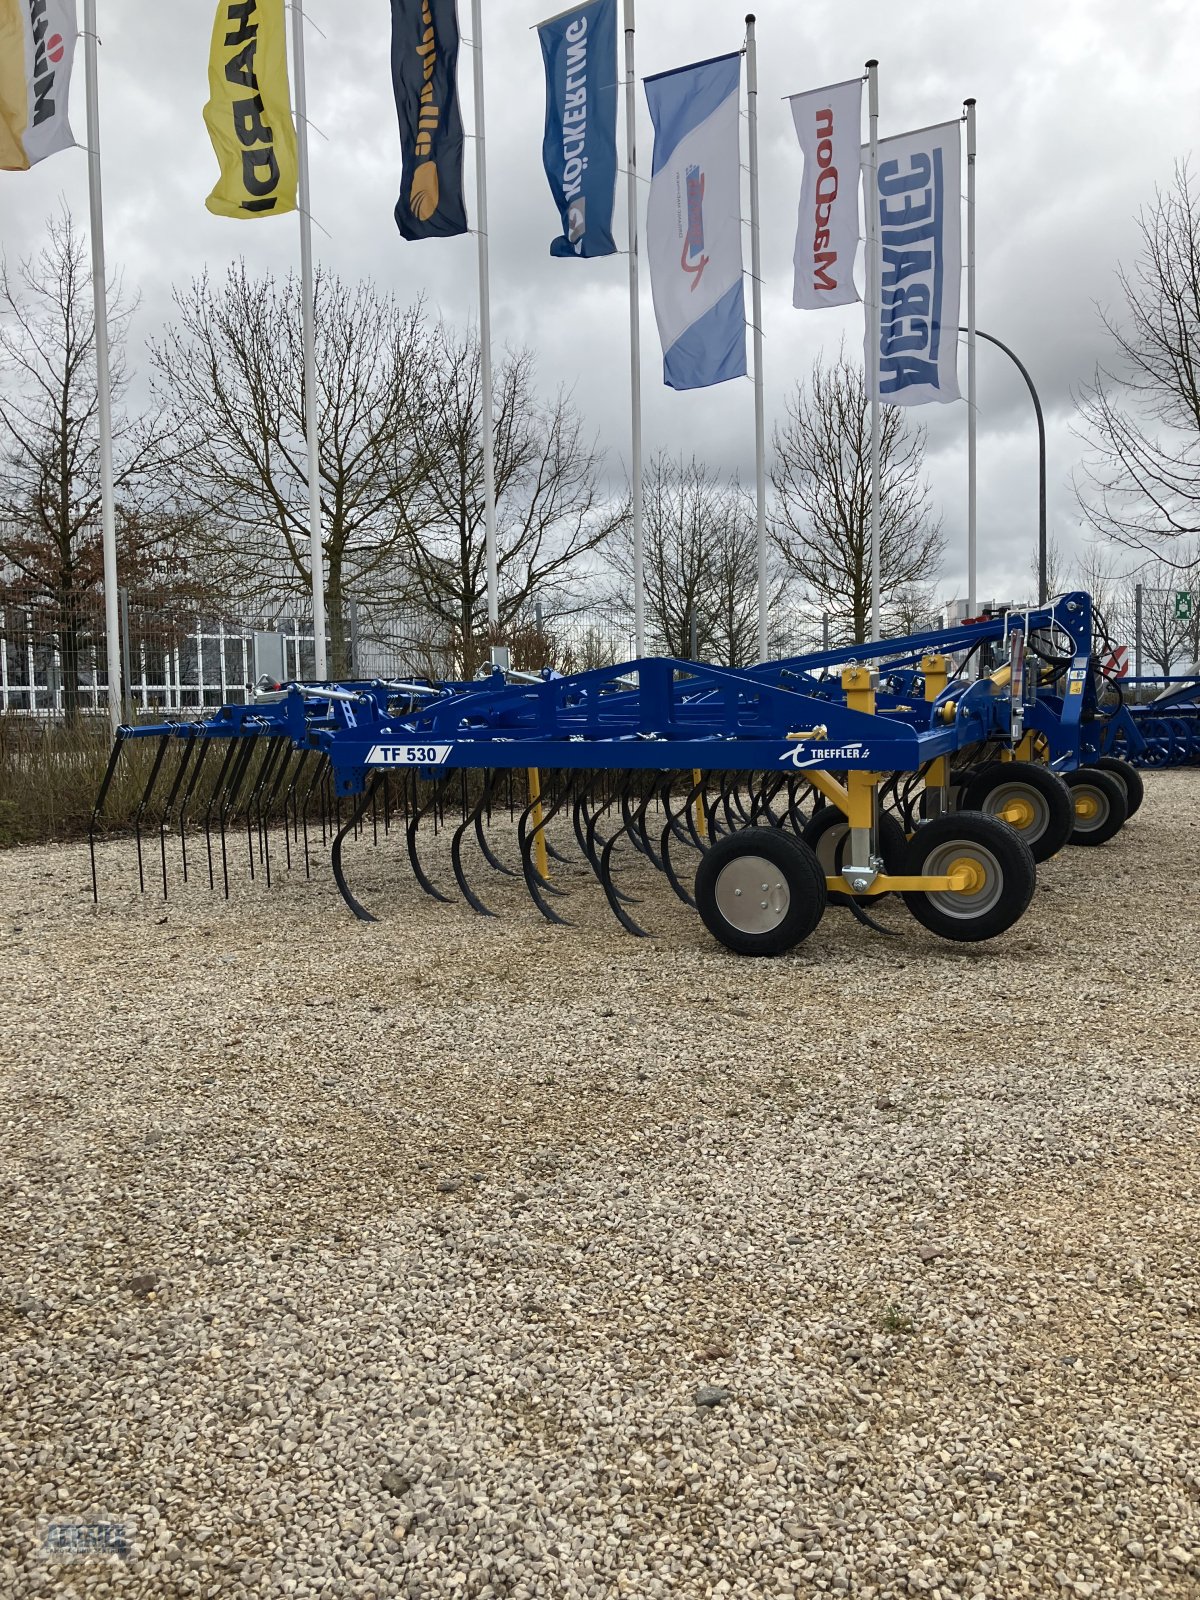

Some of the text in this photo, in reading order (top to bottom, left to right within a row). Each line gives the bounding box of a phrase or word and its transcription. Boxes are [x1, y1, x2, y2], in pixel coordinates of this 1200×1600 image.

[380, 748, 436, 761] TF 530
[810, 749, 860, 758] TREFFLER
